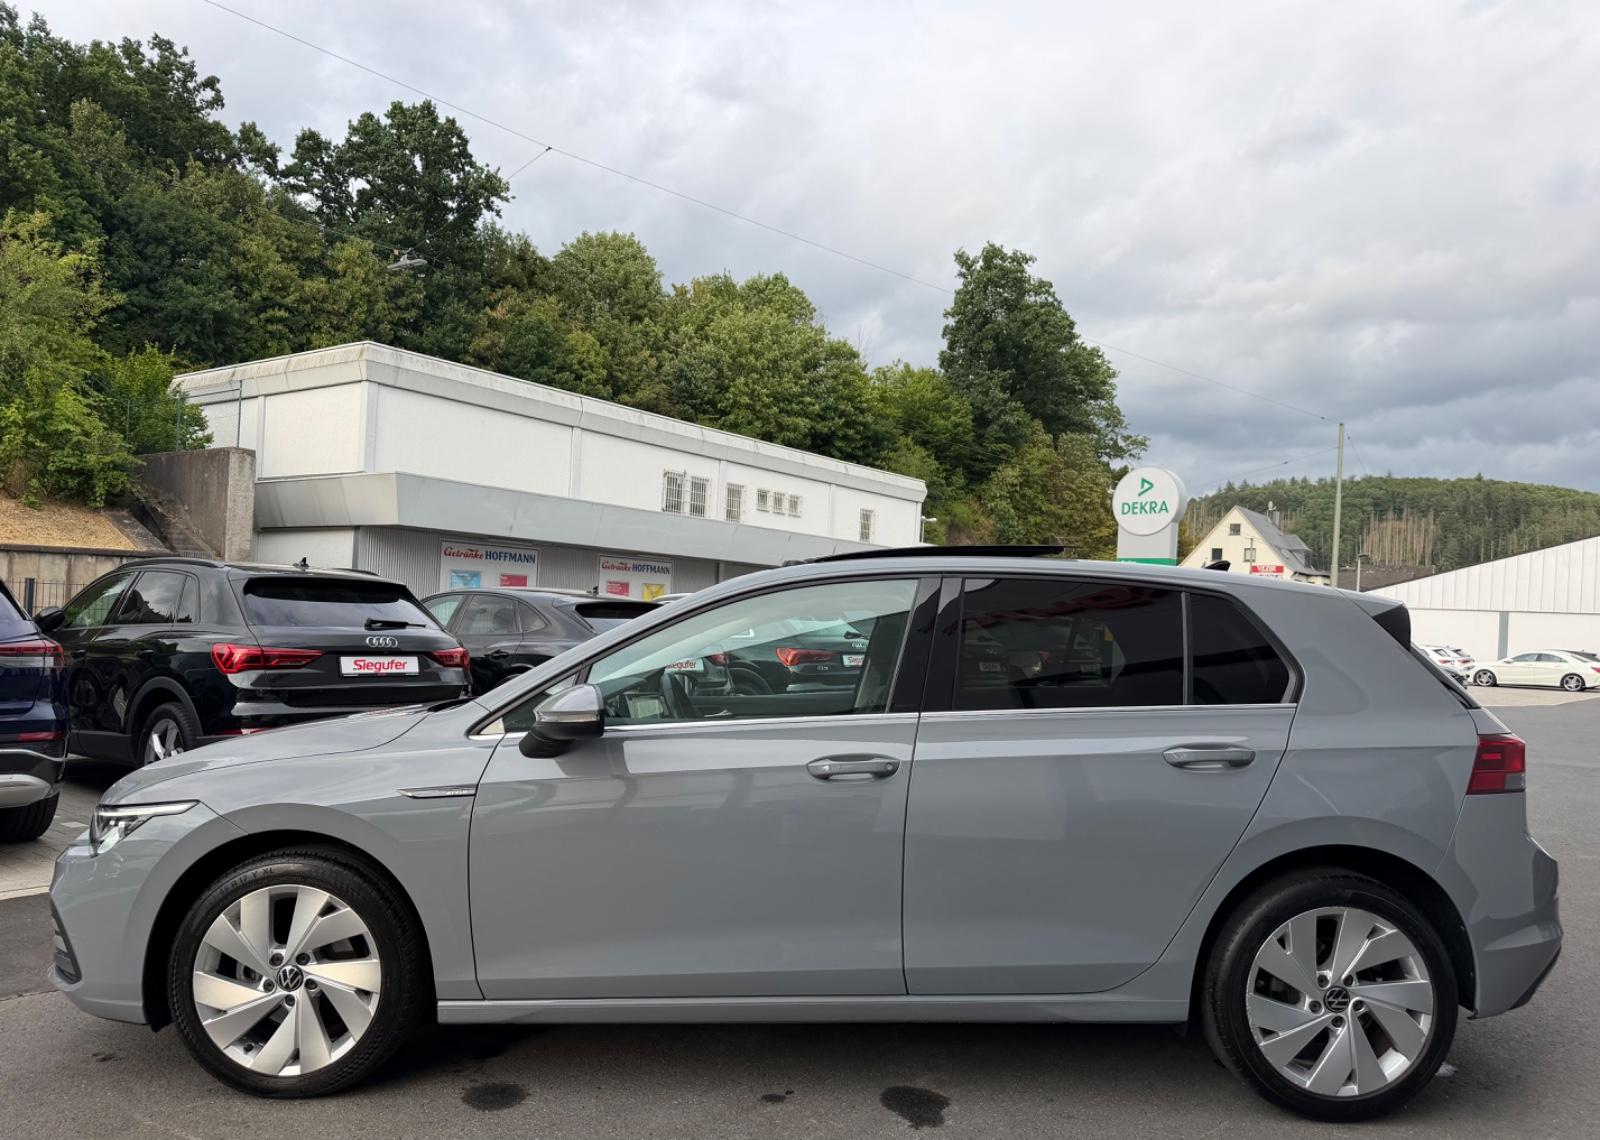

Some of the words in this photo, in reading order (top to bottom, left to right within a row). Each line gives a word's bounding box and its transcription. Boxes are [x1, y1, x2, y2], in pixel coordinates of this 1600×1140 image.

[1121, 501, 1169, 515] DEKRA
[485, 550, 536, 563] HOFFMANN
[632, 563, 670, 574] HOFFMANN
[353, 659, 407, 671] Siegufer
